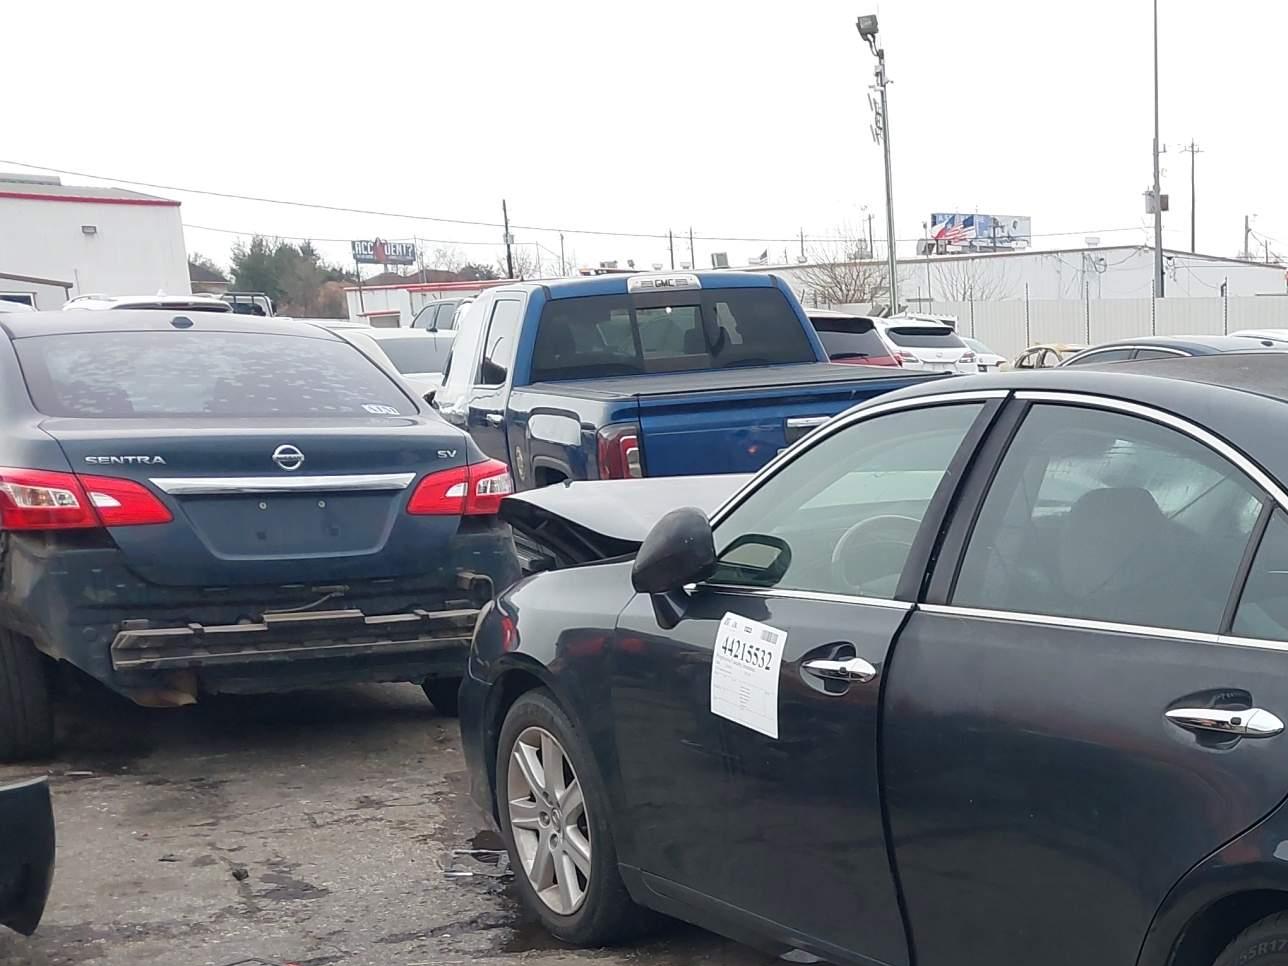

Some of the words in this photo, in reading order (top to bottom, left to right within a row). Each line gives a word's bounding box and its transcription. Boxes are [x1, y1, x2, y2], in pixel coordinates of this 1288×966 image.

[654, 279, 675, 288] GMC
[437, 449, 457, 459] SV
[85, 455, 166, 465] SENTRA
[721, 635, 773, 671] 44215532
